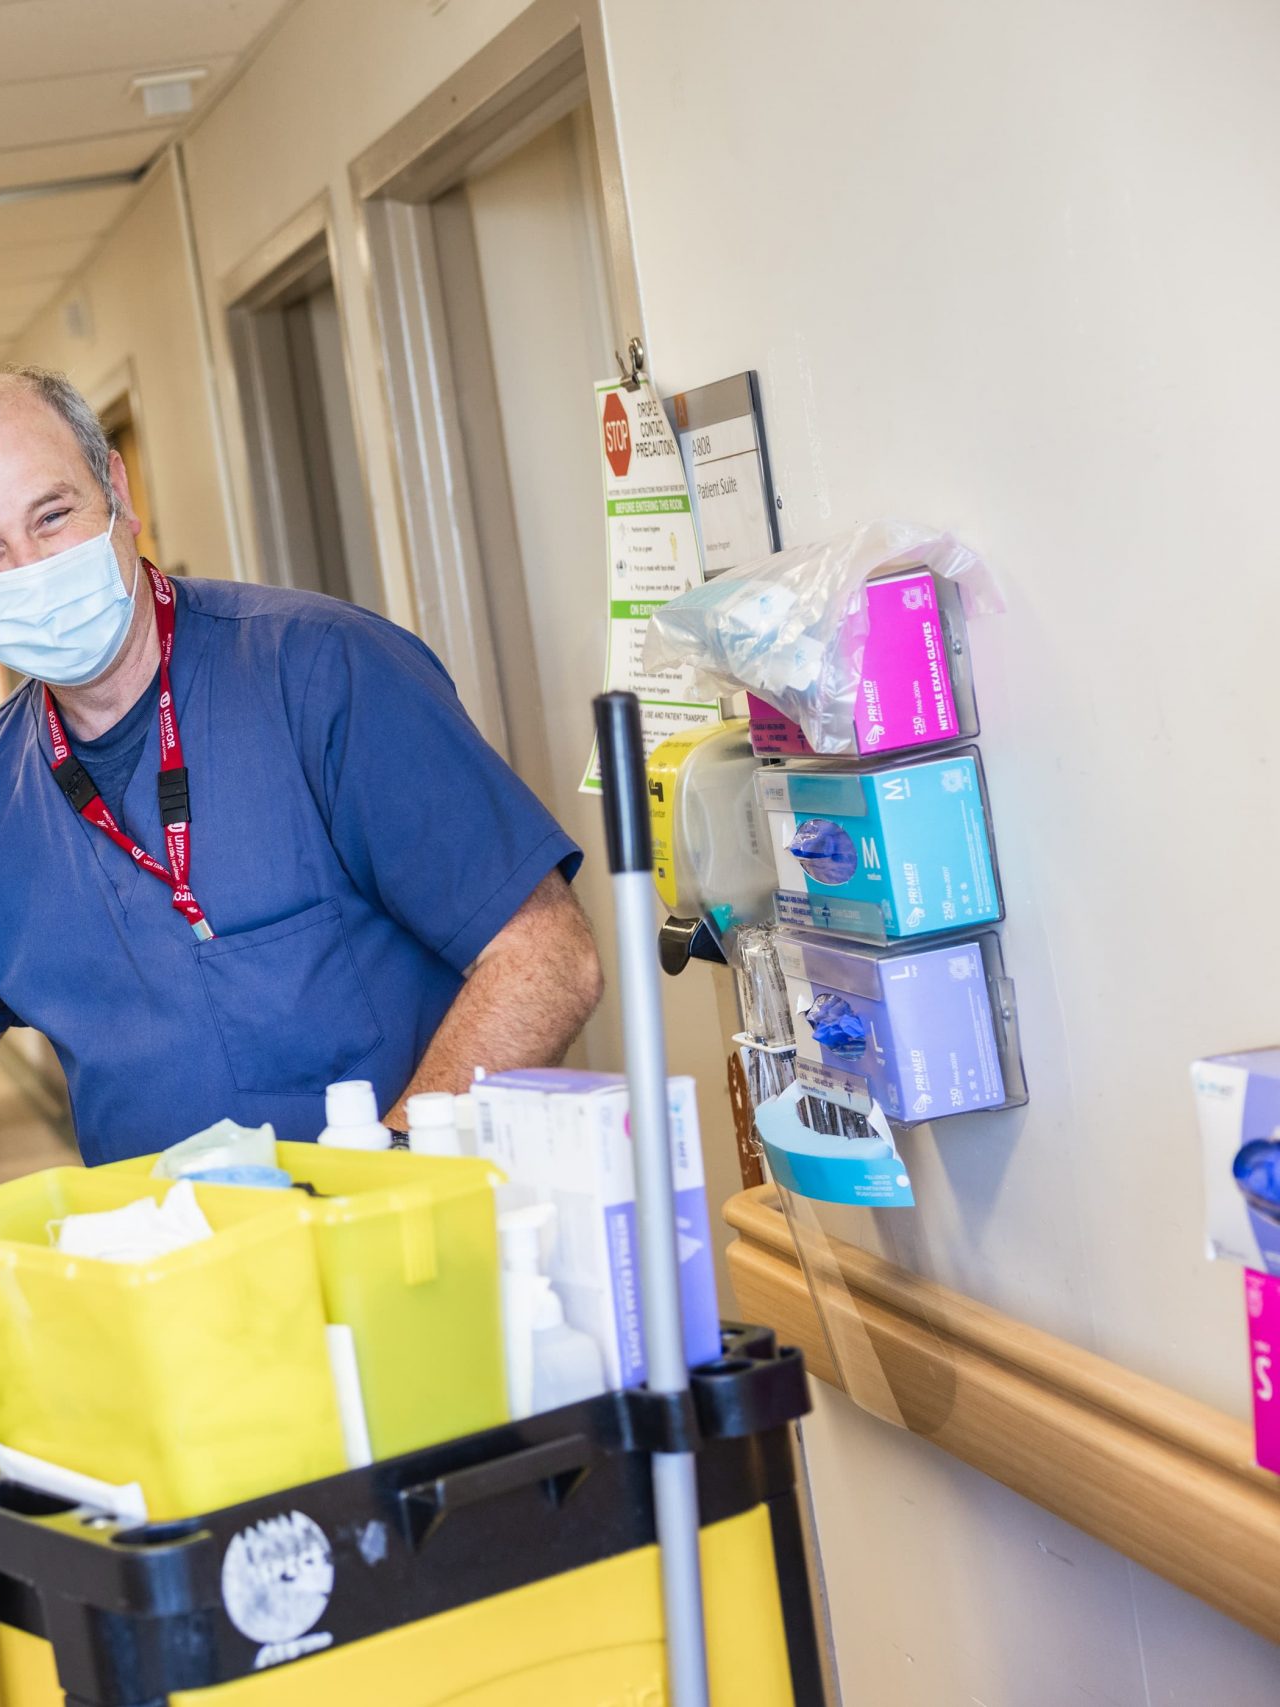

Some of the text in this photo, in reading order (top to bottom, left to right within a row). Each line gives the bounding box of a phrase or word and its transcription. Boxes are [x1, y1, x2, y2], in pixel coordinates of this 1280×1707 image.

[606, 419, 629, 453] STOP
[639, 418, 666, 438] CONTACT
[635, 439, 677, 459] PRECAUTIONS
[692, 435, 712, 458] A808
[697, 480, 720, 501] Patient
[720, 476, 738, 496] Suite
[923, 621, 936, 660] GLOVES
[927, 661, 942, 692] EXAM
[664, 711, 683, 721] PATIENT
[683, 713, 708, 723] TRANSPORT
[931, 692, 949, 732] NITRILE
[47, 710, 62, 746] UNIFOR
[163, 709, 176, 750] UNIFOR
[913, 716, 924, 736] 250
[882, 778, 905, 800] M
[861, 837, 881, 870] M
[942, 901, 954, 920] 250
[889, 965, 911, 980] L
[870, 1021, 884, 1053] L
[950, 1088, 961, 1106] 250
